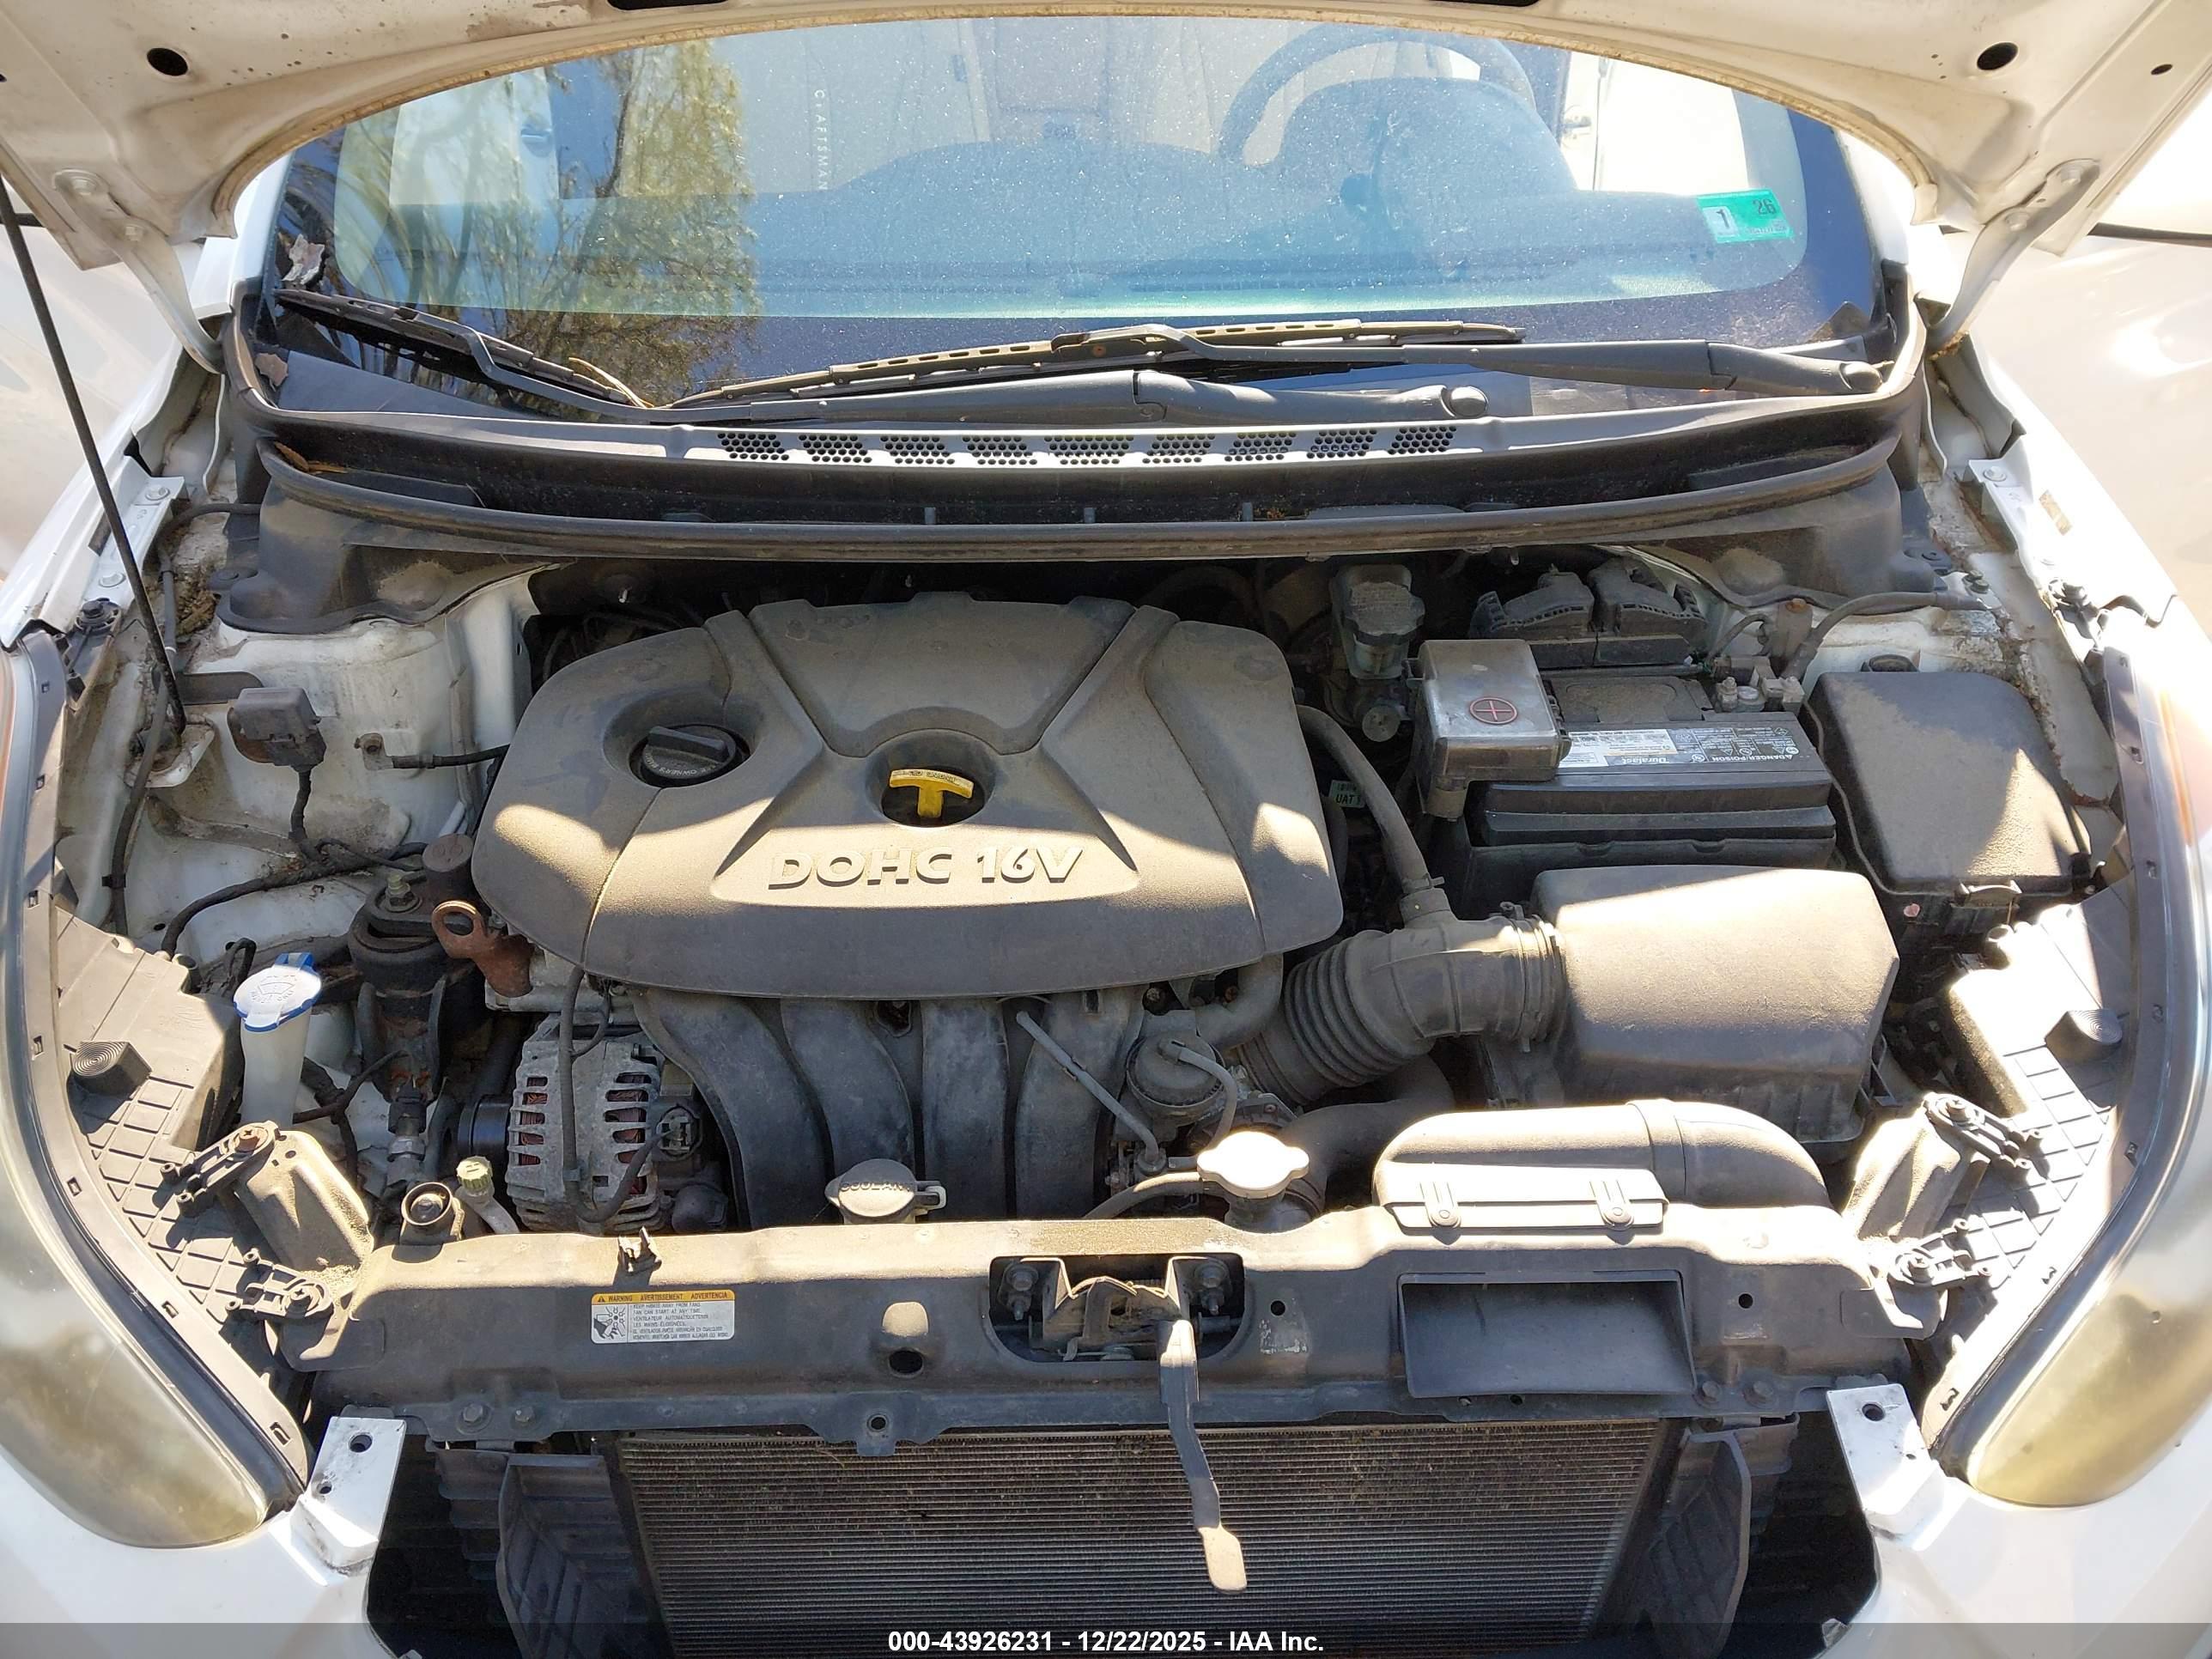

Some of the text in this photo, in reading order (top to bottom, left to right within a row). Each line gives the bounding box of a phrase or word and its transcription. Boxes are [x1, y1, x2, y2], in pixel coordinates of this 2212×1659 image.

[1753, 198, 1777, 216] 26
[1716, 209, 1730, 228] 1
[769, 846, 1084, 890] DOHC 16V
[690, 1291, 728, 1300] ADVERTENCIA
